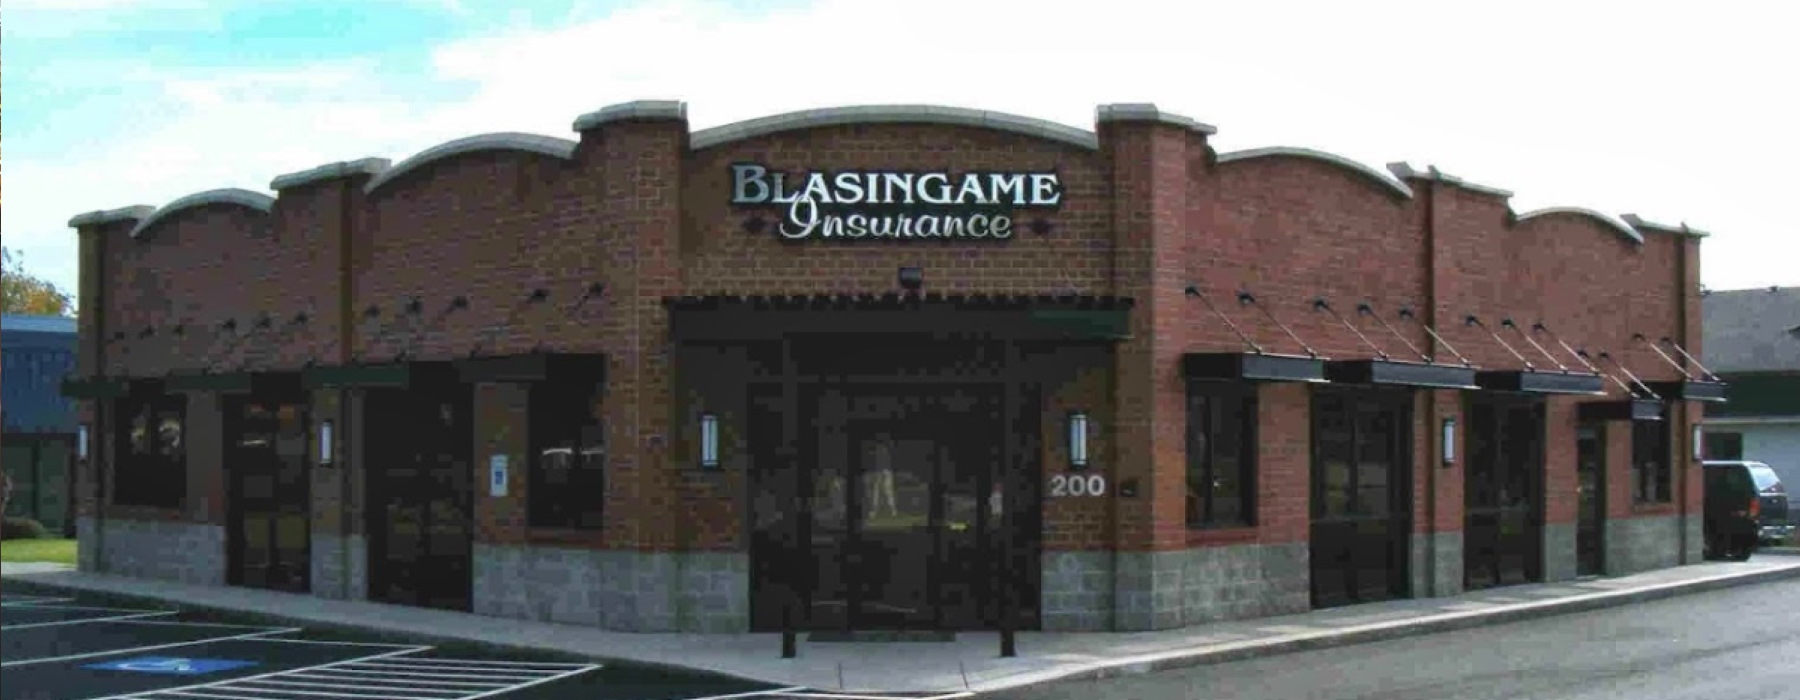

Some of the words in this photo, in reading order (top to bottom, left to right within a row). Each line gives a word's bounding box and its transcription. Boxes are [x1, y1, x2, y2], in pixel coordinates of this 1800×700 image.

[732, 165, 1061, 205] BLASINGAME
[779, 192, 1012, 239] Insurance
[1051, 474, 1105, 497] 200
